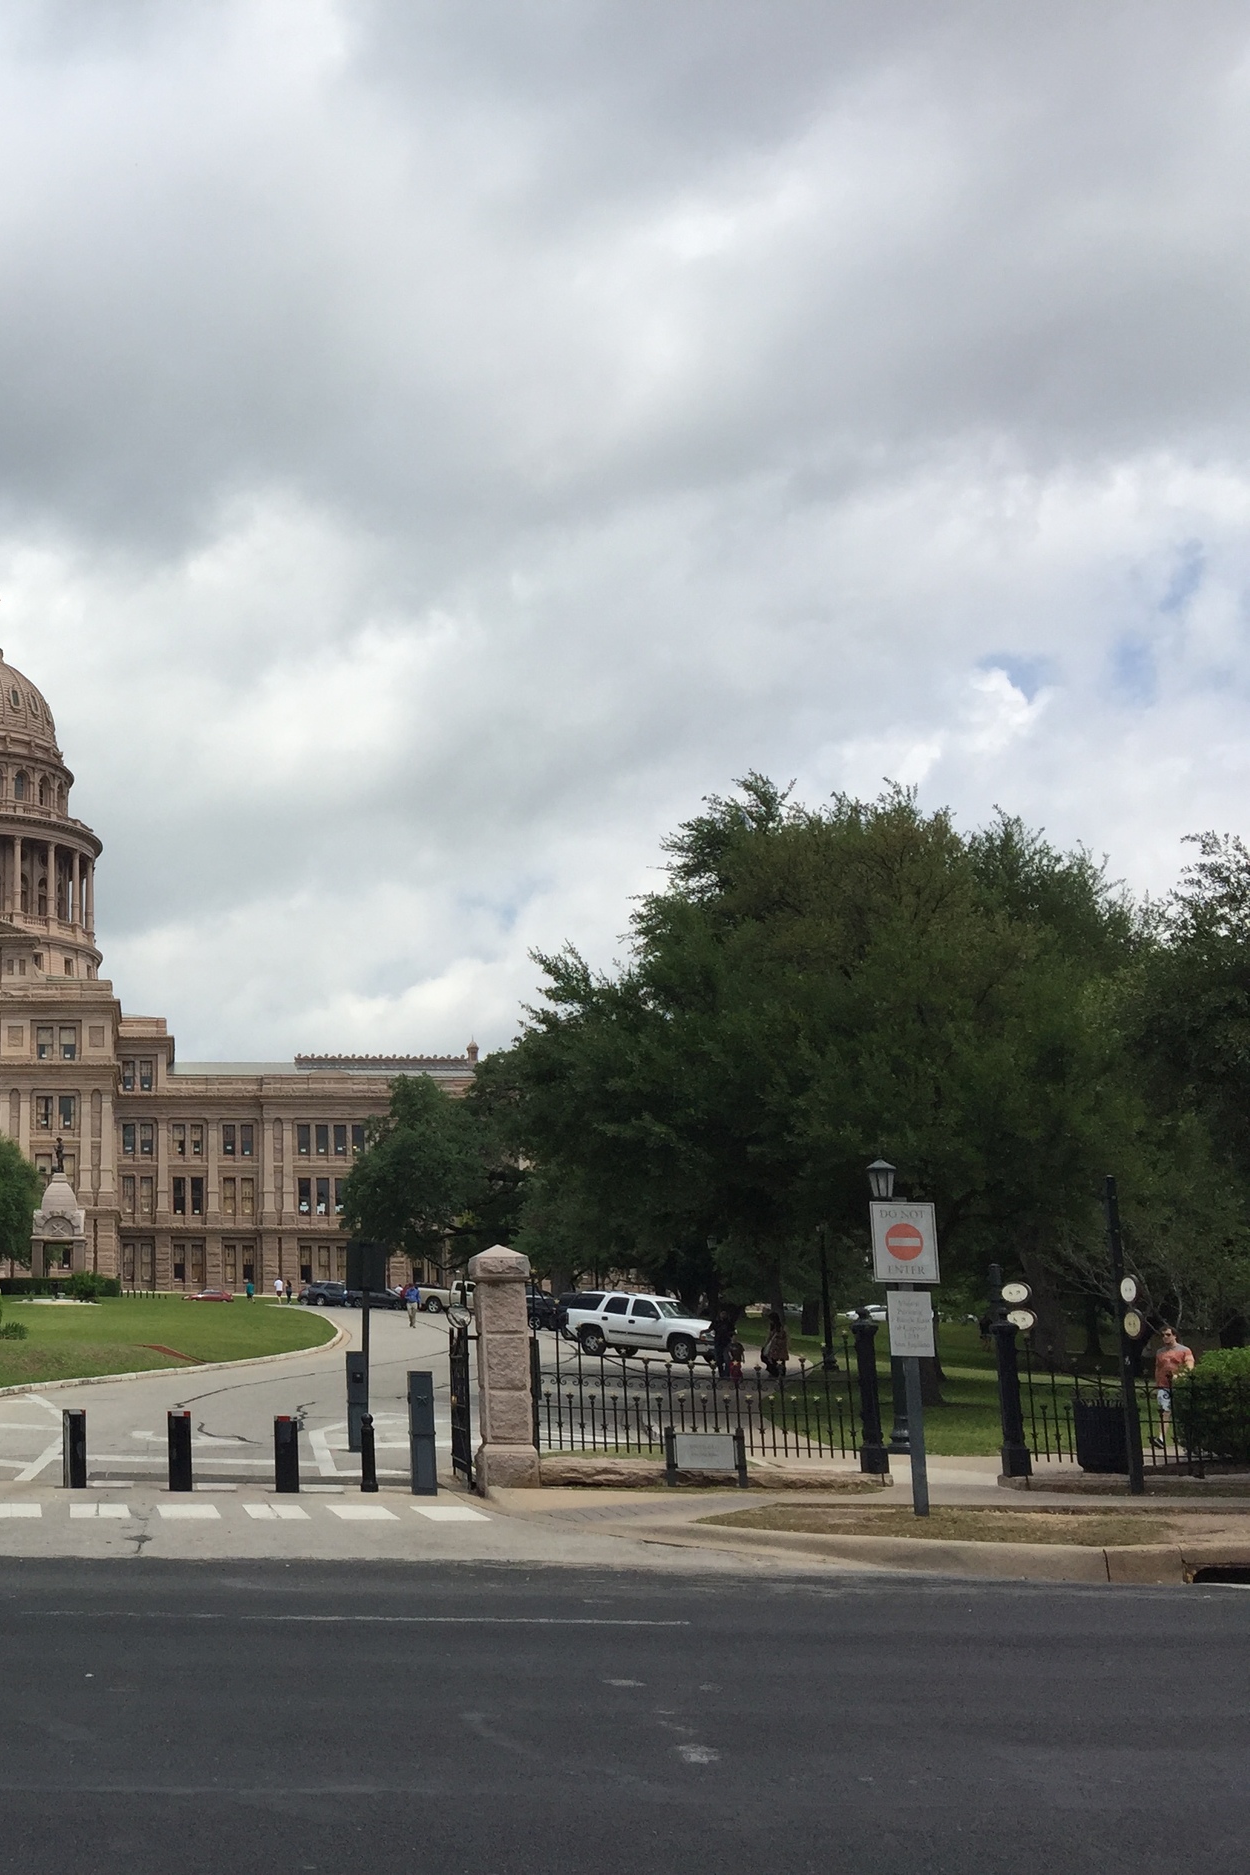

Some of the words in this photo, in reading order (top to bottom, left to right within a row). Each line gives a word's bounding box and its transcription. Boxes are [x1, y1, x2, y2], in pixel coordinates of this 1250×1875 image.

[879, 1209, 898, 1219] DO
[900, 1209, 926, 1219] NOT
[888, 1264, 926, 1275] ENTER
